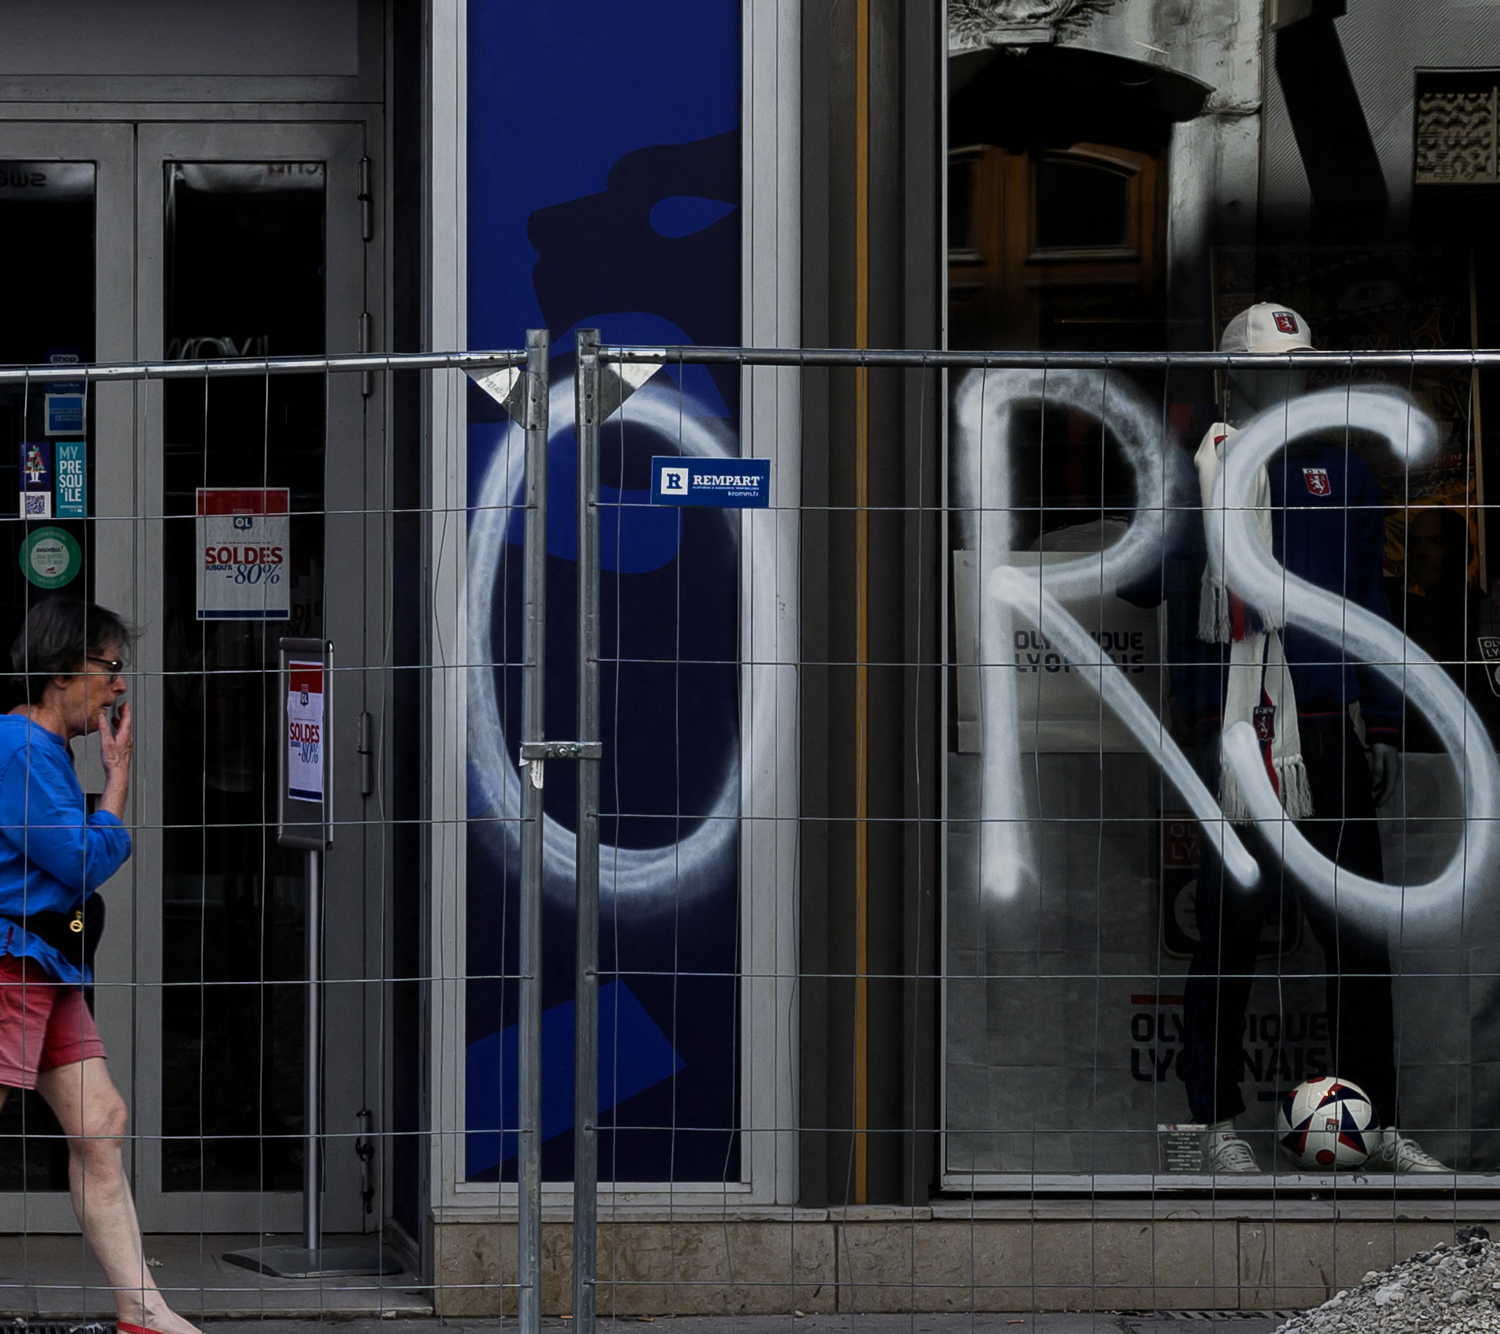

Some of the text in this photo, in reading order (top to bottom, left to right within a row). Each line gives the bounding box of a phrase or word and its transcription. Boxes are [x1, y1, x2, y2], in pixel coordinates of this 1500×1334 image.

[59, 446, 79, 460] MY
[59, 460, 82, 474] PRE
[59, 474, 83, 488] SQU
[692, 474, 760, 486] REMPART
[205, 547, 284, 565] SOLDES
[226, 563, 280, 585] -80%
[290, 722, 319, 744] SOLDES
